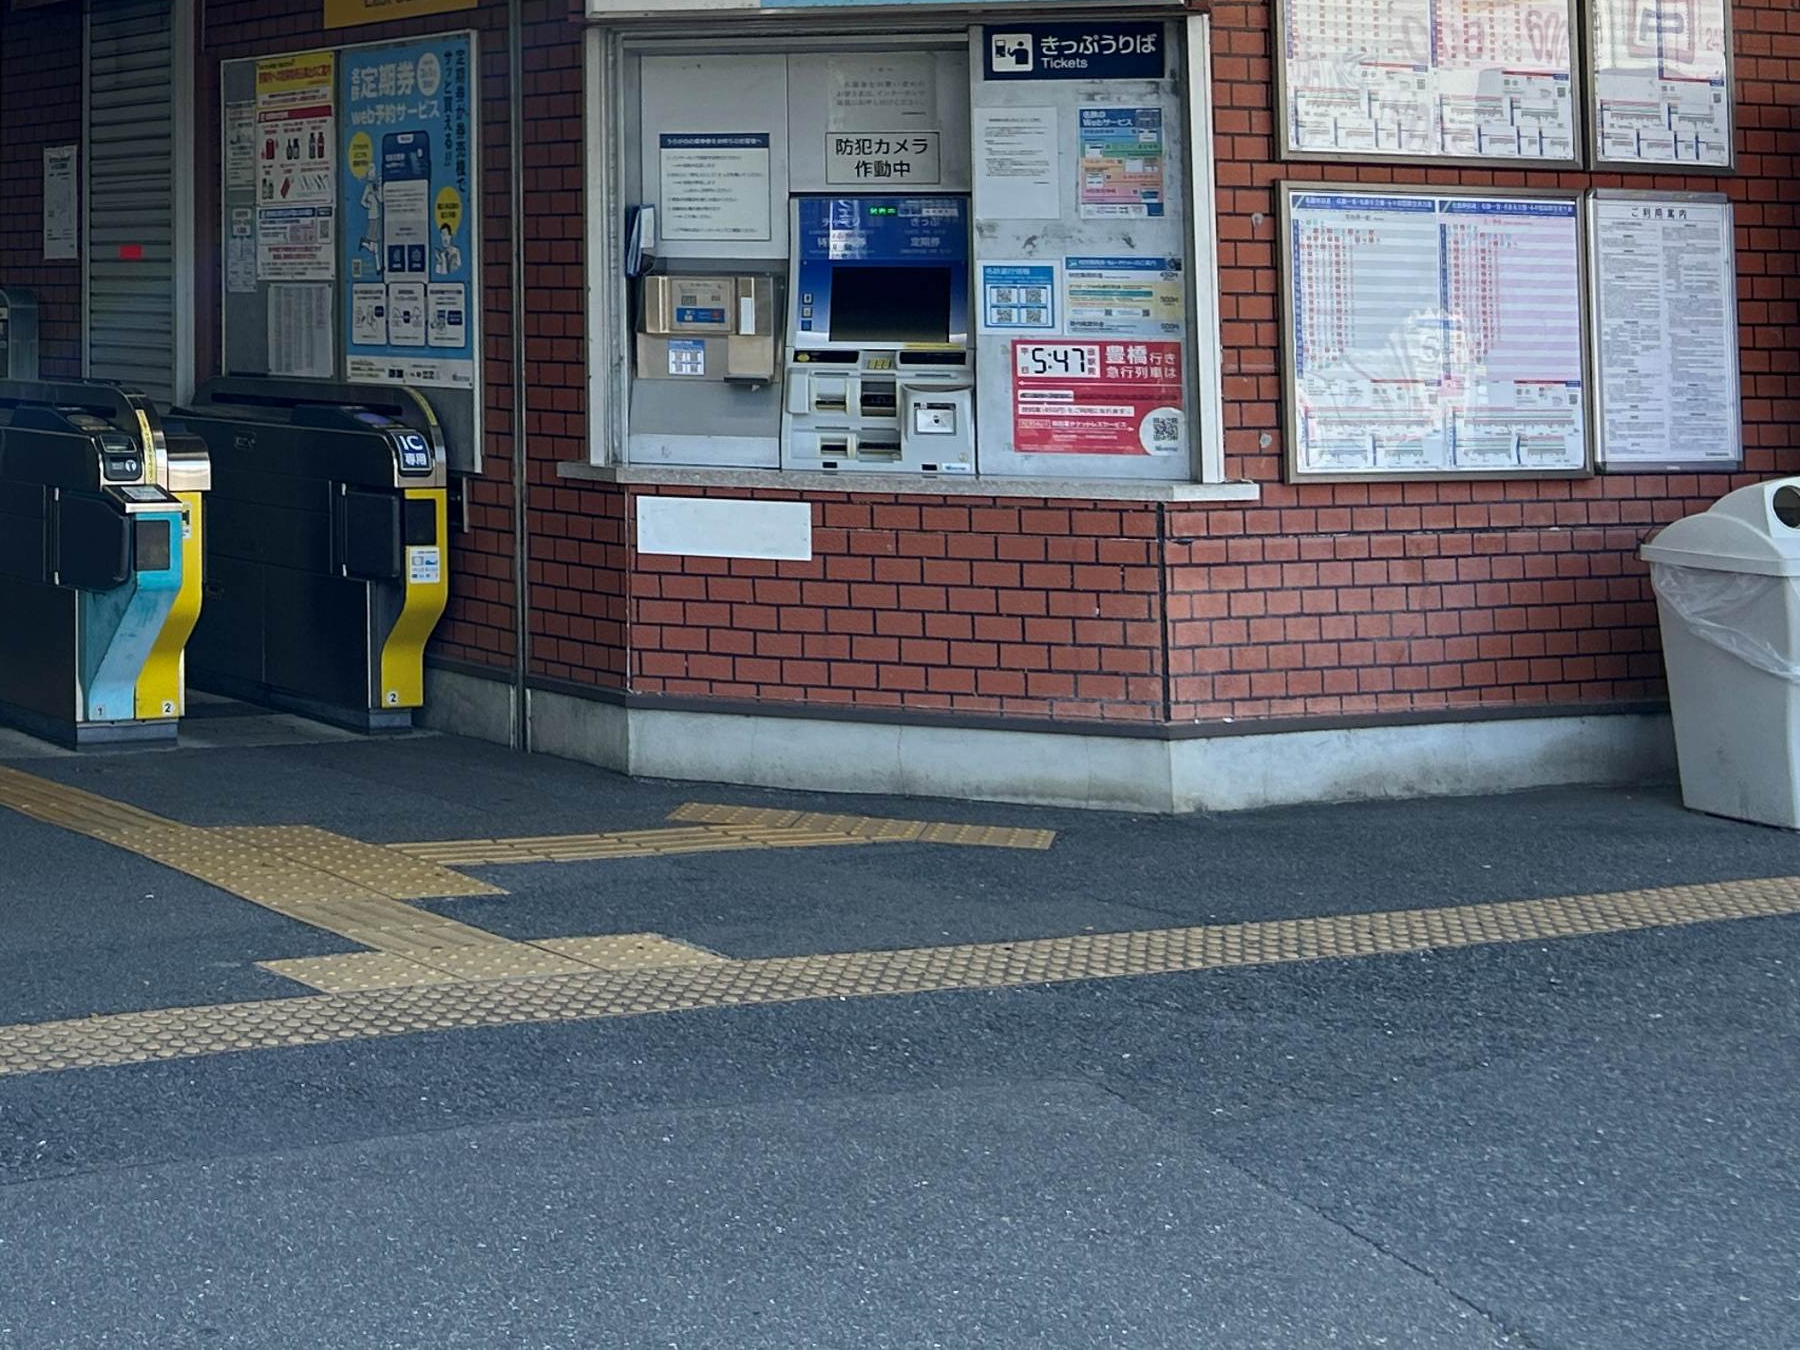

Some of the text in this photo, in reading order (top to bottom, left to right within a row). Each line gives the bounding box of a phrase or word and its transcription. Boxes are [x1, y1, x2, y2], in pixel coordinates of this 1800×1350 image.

[1040, 33, 1157, 55] きっぷうりば
[1041, 56, 1088, 69] Tickets
[360, 60, 415, 99] 定期券
[835, 138, 928, 156] 防犯カメラ
[855, 160, 911, 178] 作動中
[1032, 347, 1085, 374] 5:47
[1105, 345, 1177, 365] 豊橋行き
[1106, 366, 1177, 379] 急行列車は
[398, 435, 424, 451] IC
[390, 693, 396, 702] 2
[164, 703, 171, 713] 2
